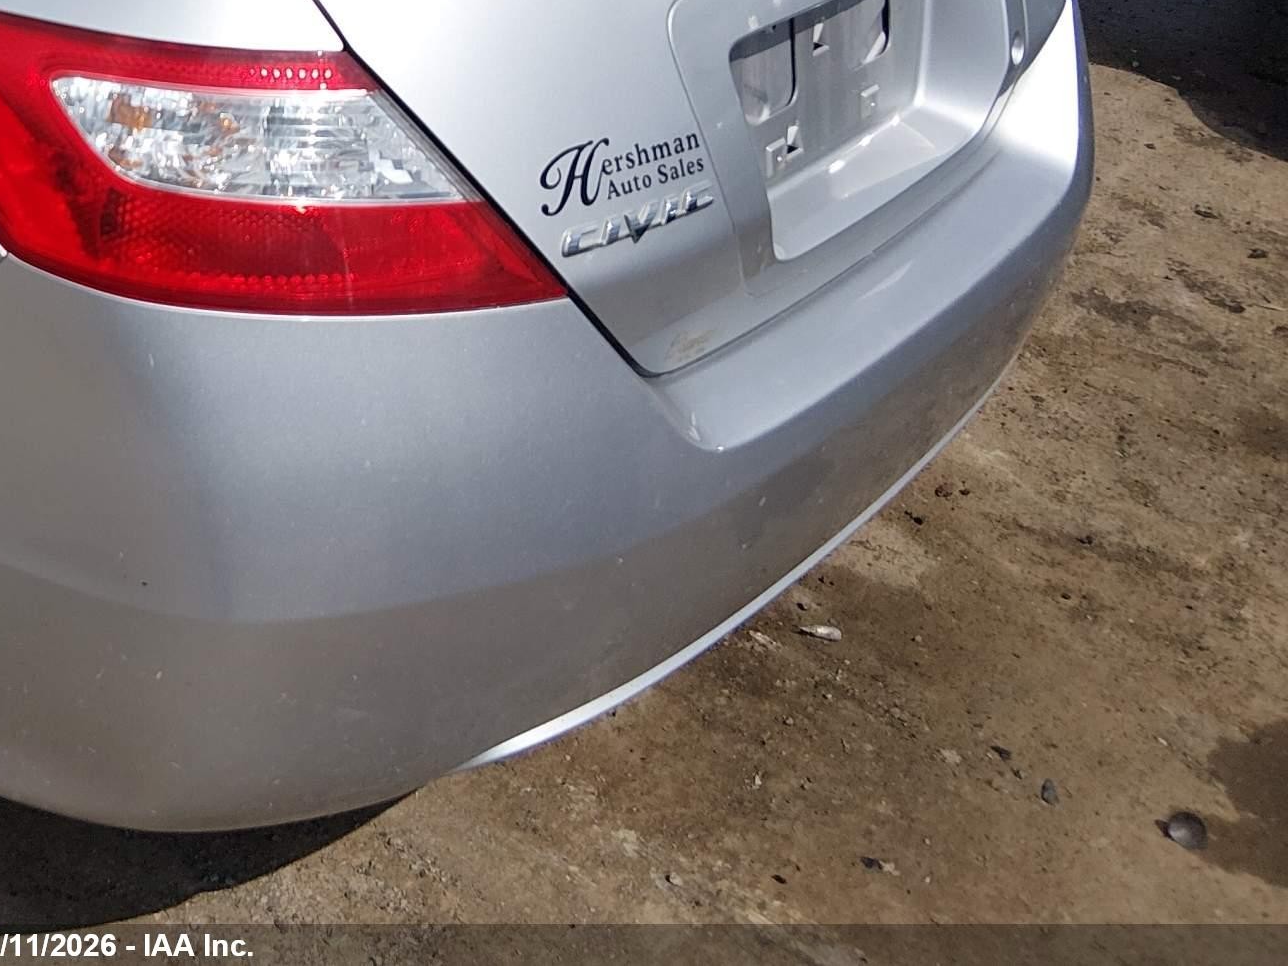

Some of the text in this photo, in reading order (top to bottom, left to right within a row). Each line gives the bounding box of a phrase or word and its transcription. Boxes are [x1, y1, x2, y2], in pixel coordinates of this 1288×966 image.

[539, 132, 701, 217] Hershman
[606, 156, 705, 200] Auto Sales
[561, 180, 714, 258] CIVIC
